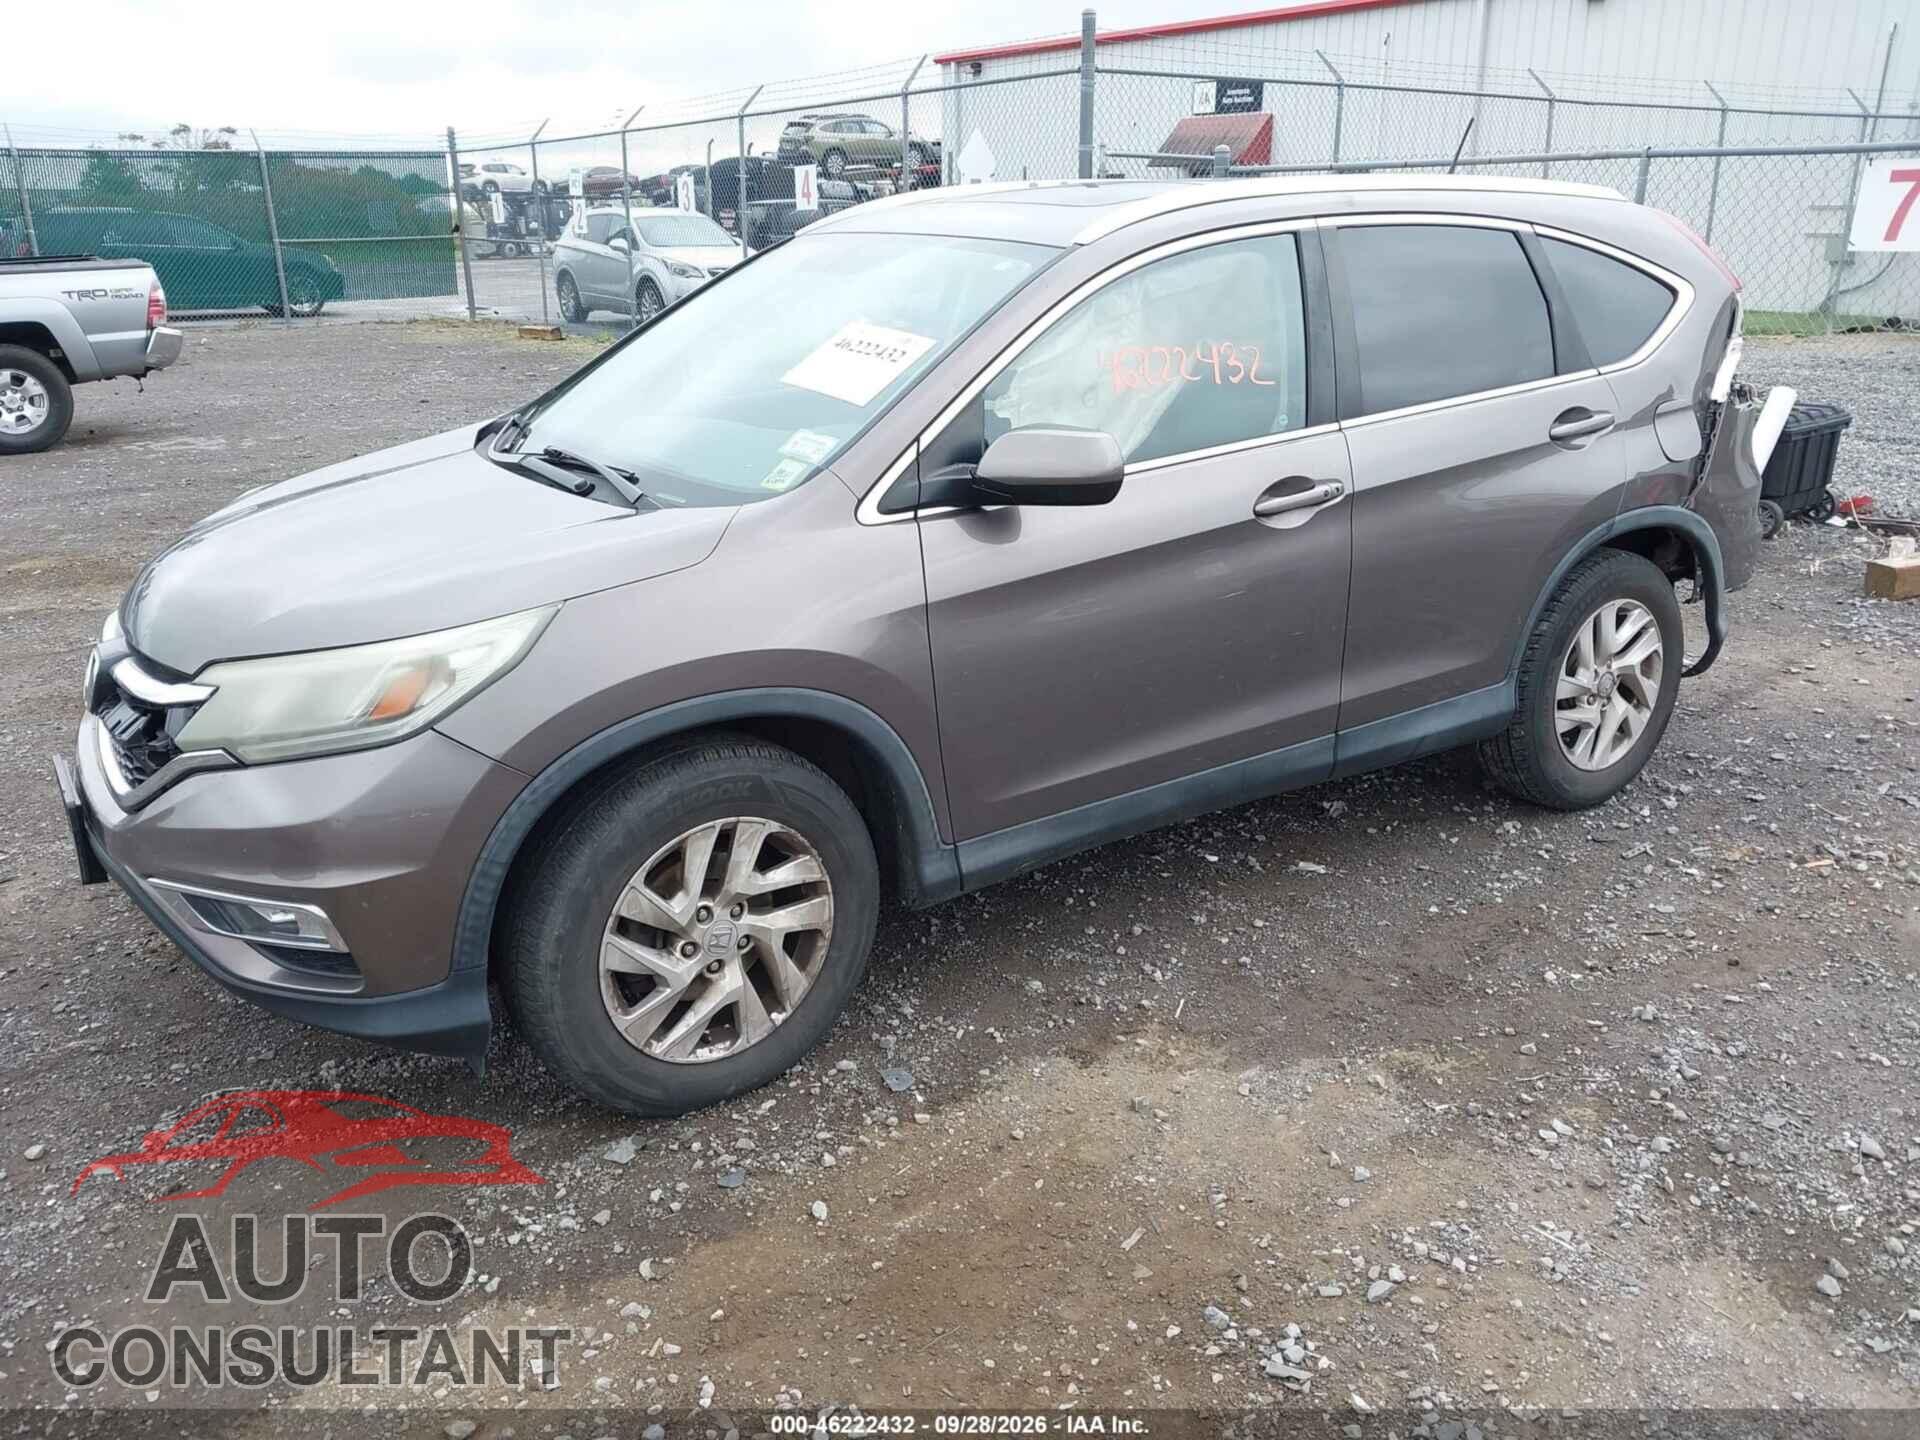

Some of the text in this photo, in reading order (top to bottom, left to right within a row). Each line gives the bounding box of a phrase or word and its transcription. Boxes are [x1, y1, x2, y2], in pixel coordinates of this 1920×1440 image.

[681, 179, 691, 212] 3
[801, 169, 812, 206] 4
[1884, 169, 1920, 241] 7
